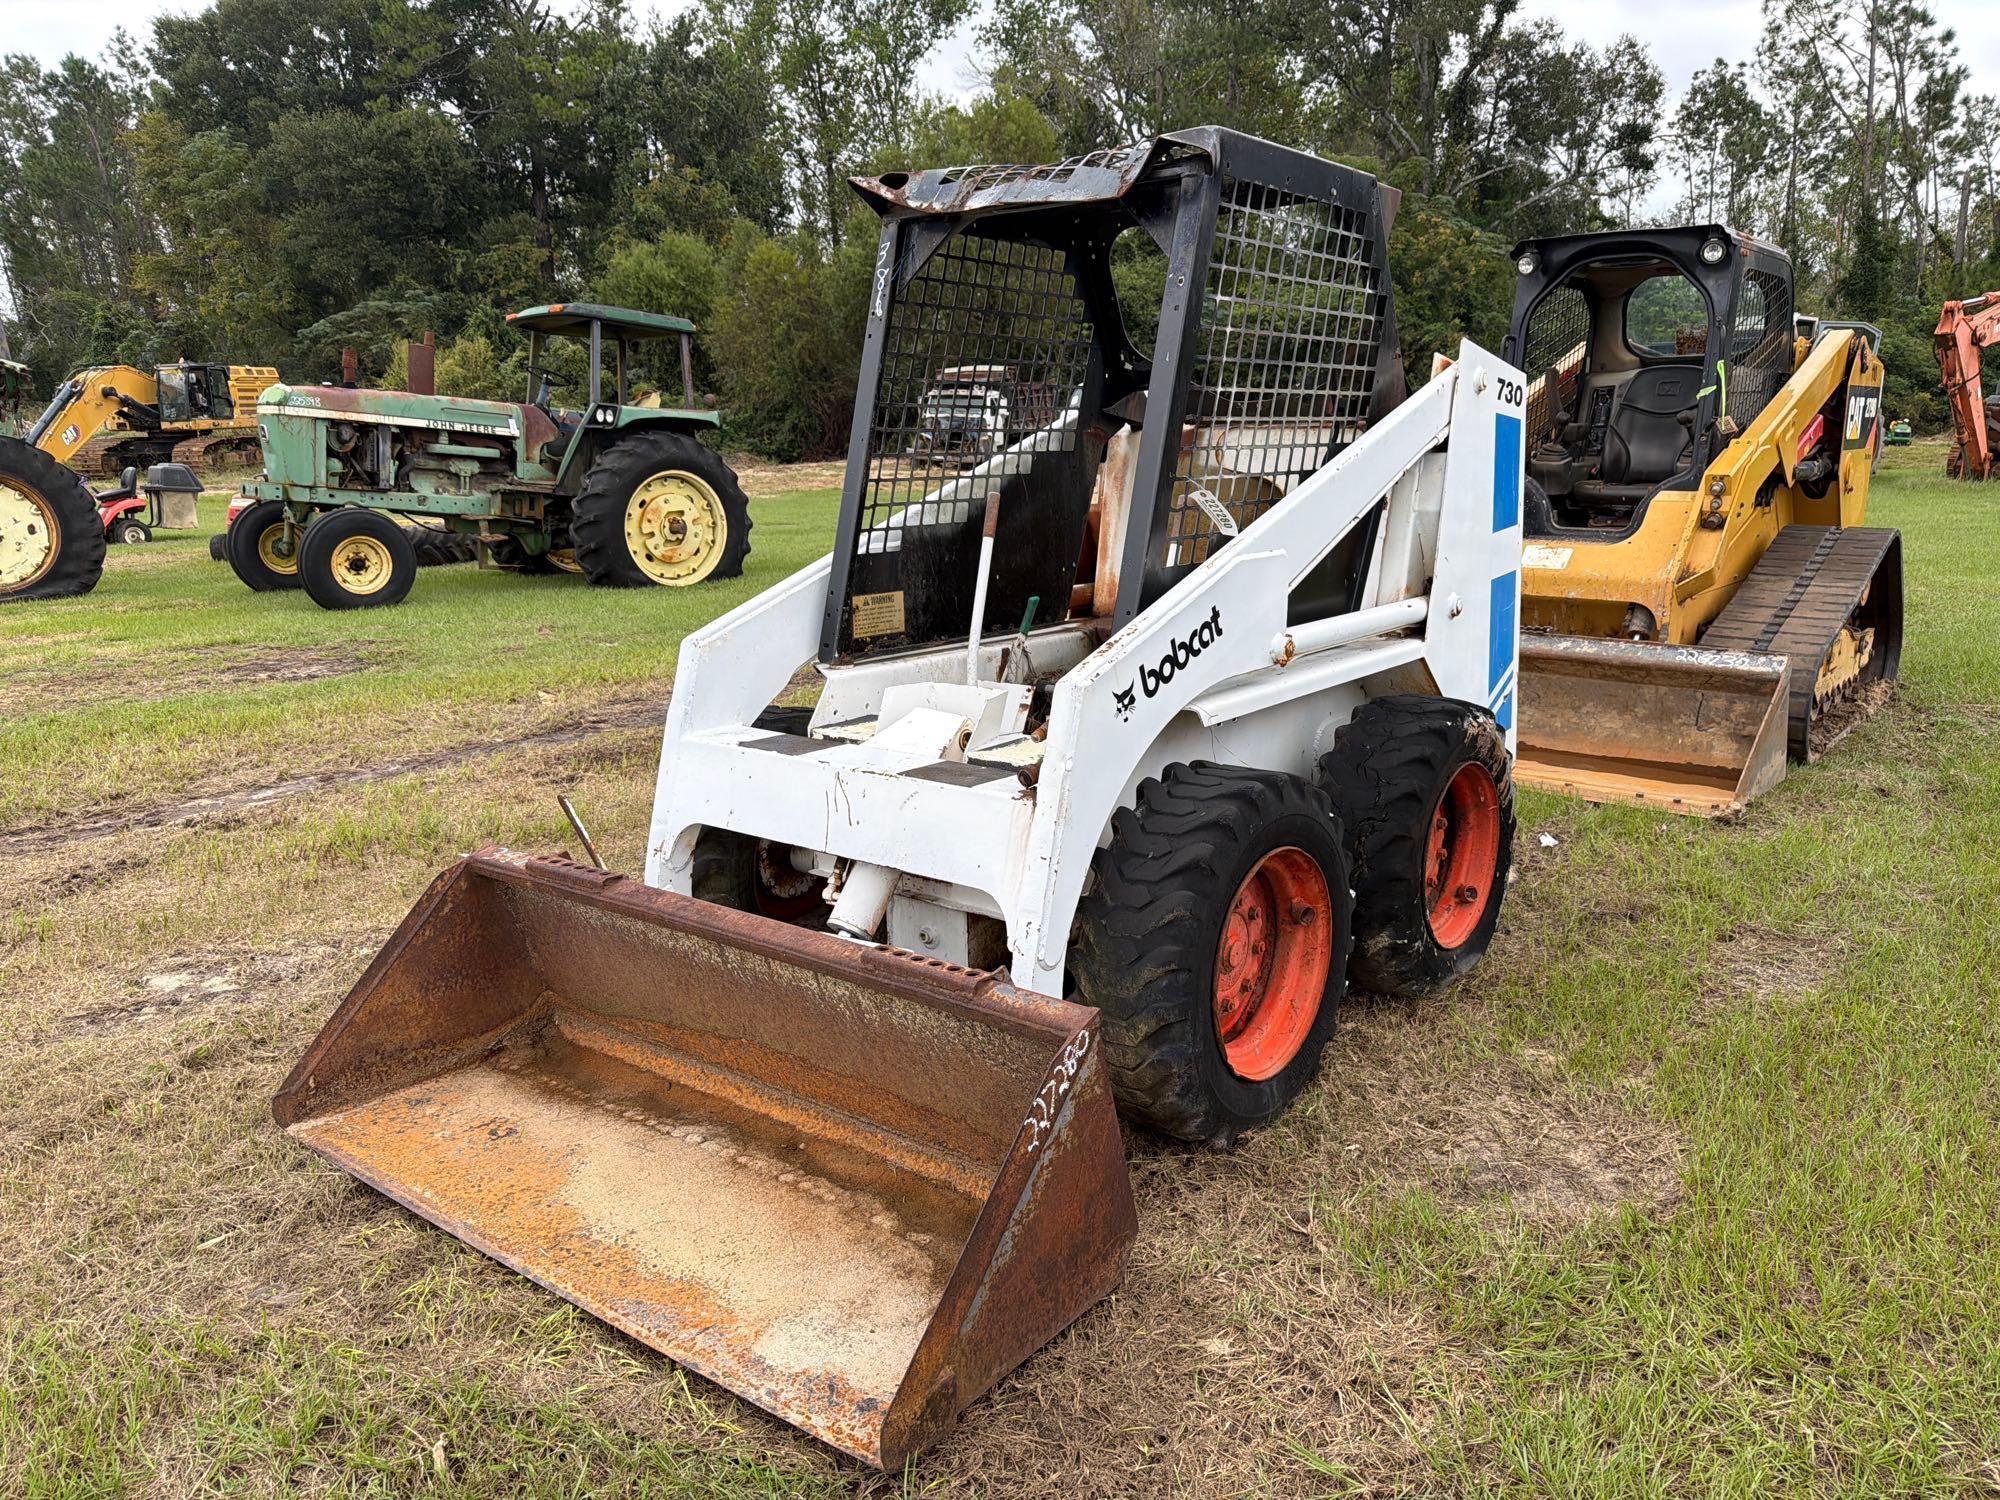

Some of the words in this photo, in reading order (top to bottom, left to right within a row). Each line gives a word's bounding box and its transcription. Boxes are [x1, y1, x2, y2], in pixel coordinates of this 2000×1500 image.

[1497, 377, 1523, 407] 730
[425, 420, 455, 430] JOHN
[461, 424, 497, 434] DEERE
[1845, 395, 1866, 440] CAT
[61, 425, 77, 446] CAT
[1204, 499, 1233, 529] 227280
[870, 594, 895, 606] WARNING
[1139, 604, 1223, 698] bobcat
[1023, 1029, 1090, 1153] 227280
